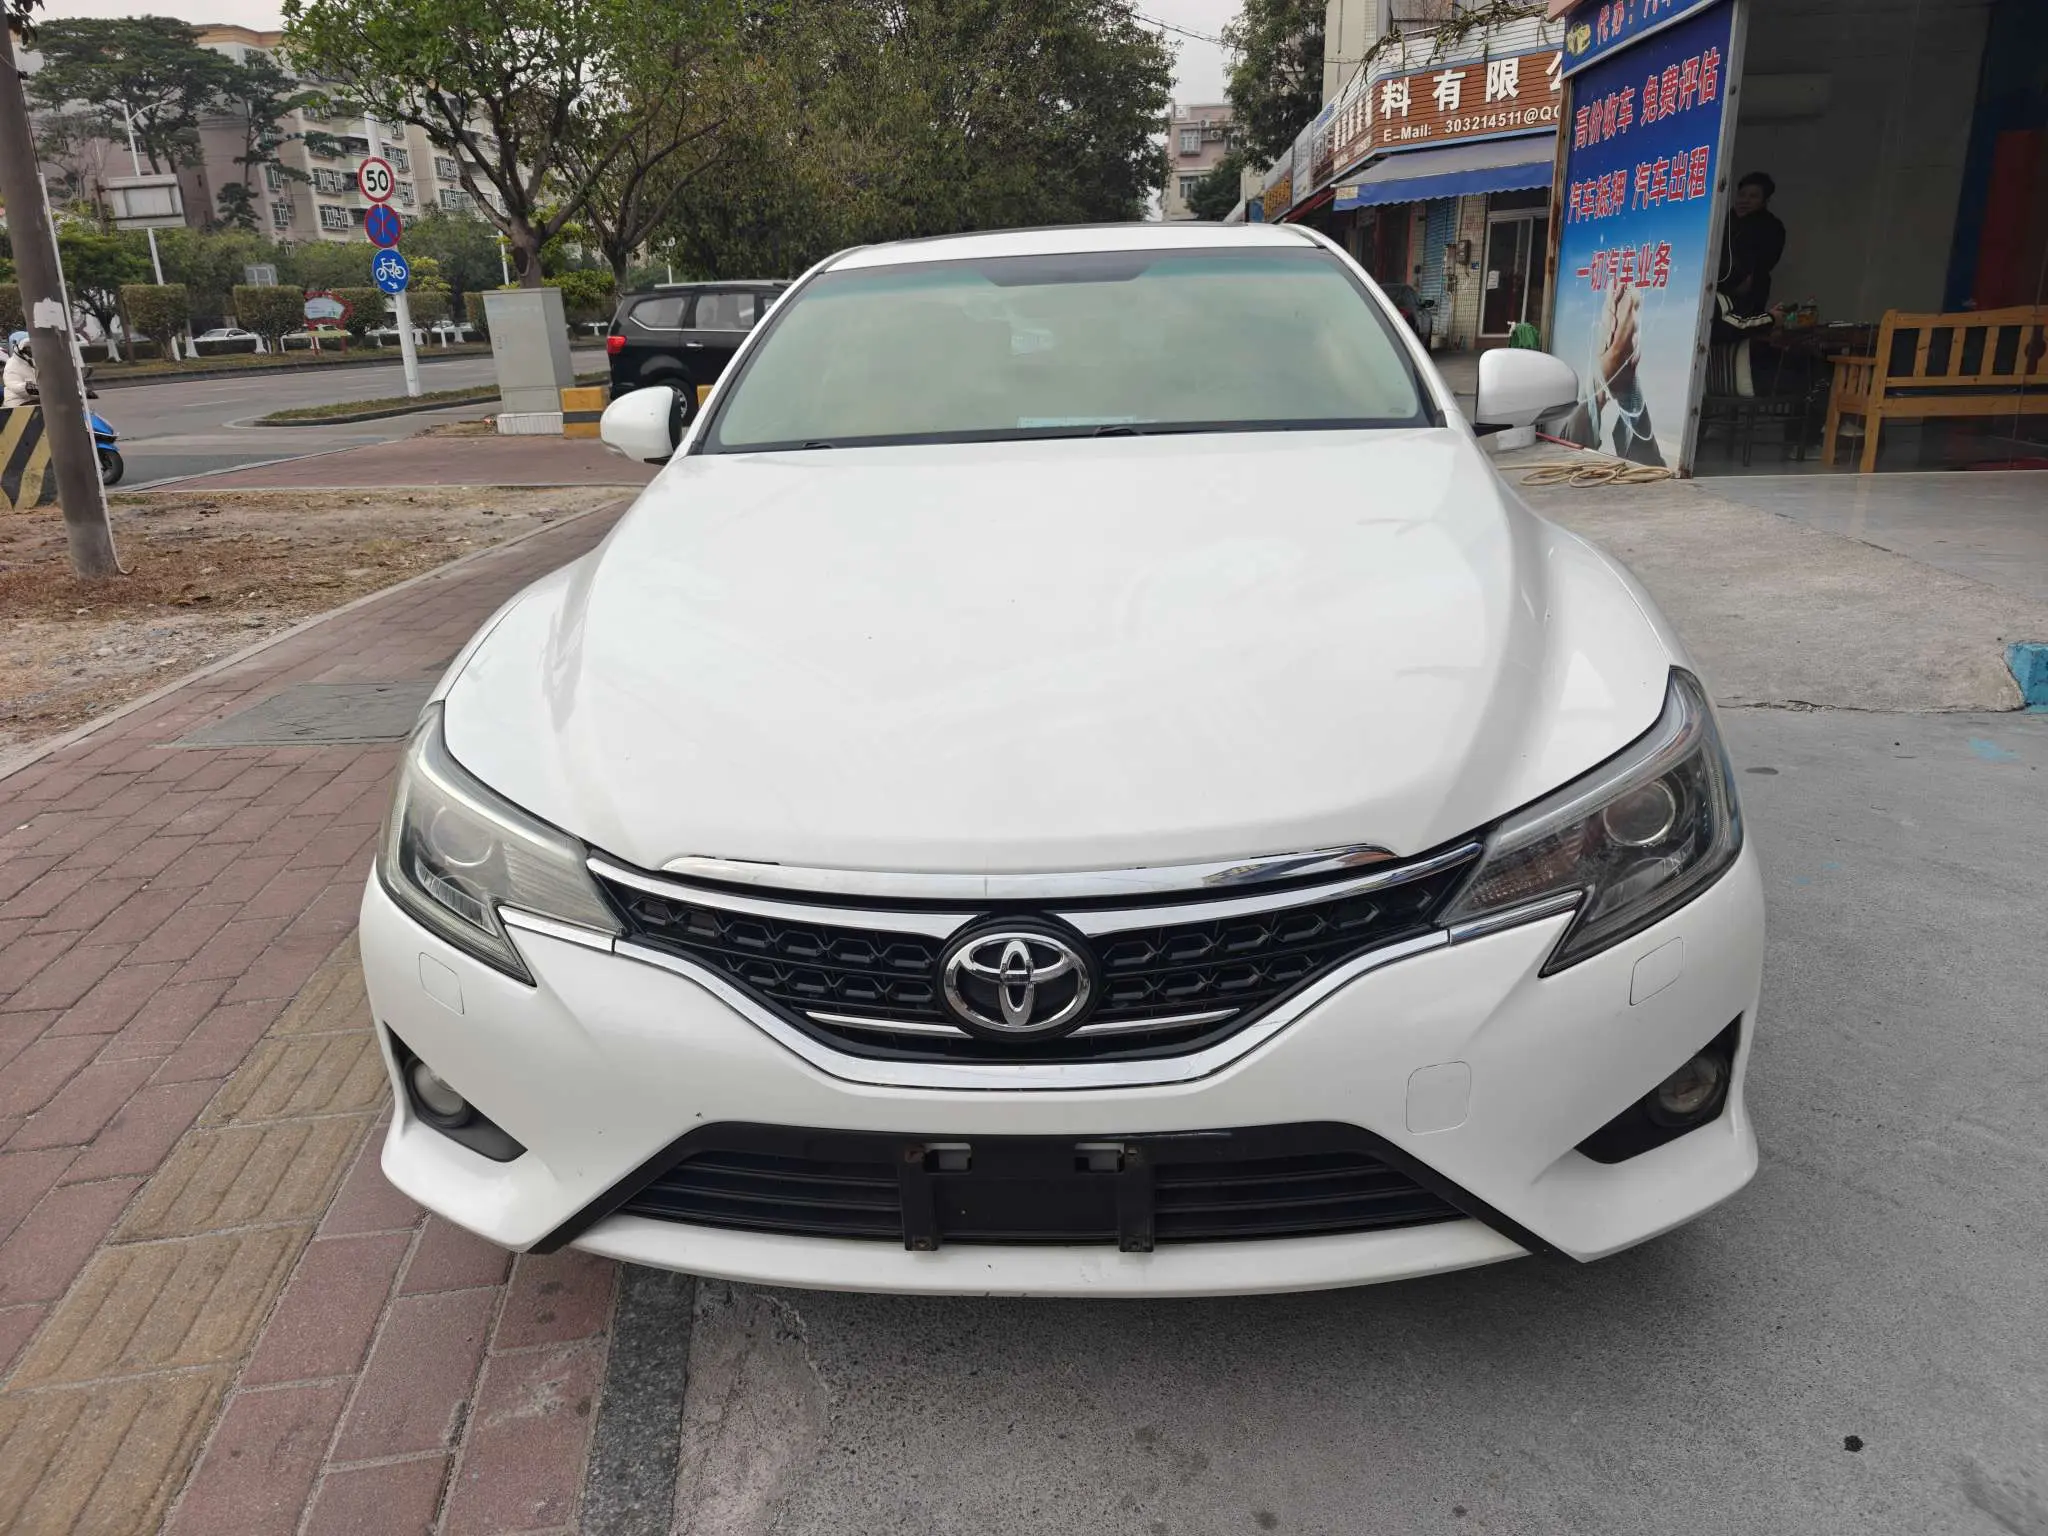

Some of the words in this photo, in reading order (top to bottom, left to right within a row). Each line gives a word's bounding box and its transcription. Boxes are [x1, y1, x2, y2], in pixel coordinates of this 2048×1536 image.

[1574, 86, 1635, 151] 高价收车
[1641, 46, 1720, 127] 免费评估
[1383, 124, 1432, 142] E-Mail:
[366, 169, 389, 192] 50
[1568, 170, 1628, 224] 汽车抵押
[1632, 145, 1710, 211] 汽车出租
[1576, 240, 1672, 291] 一切汽车业务
